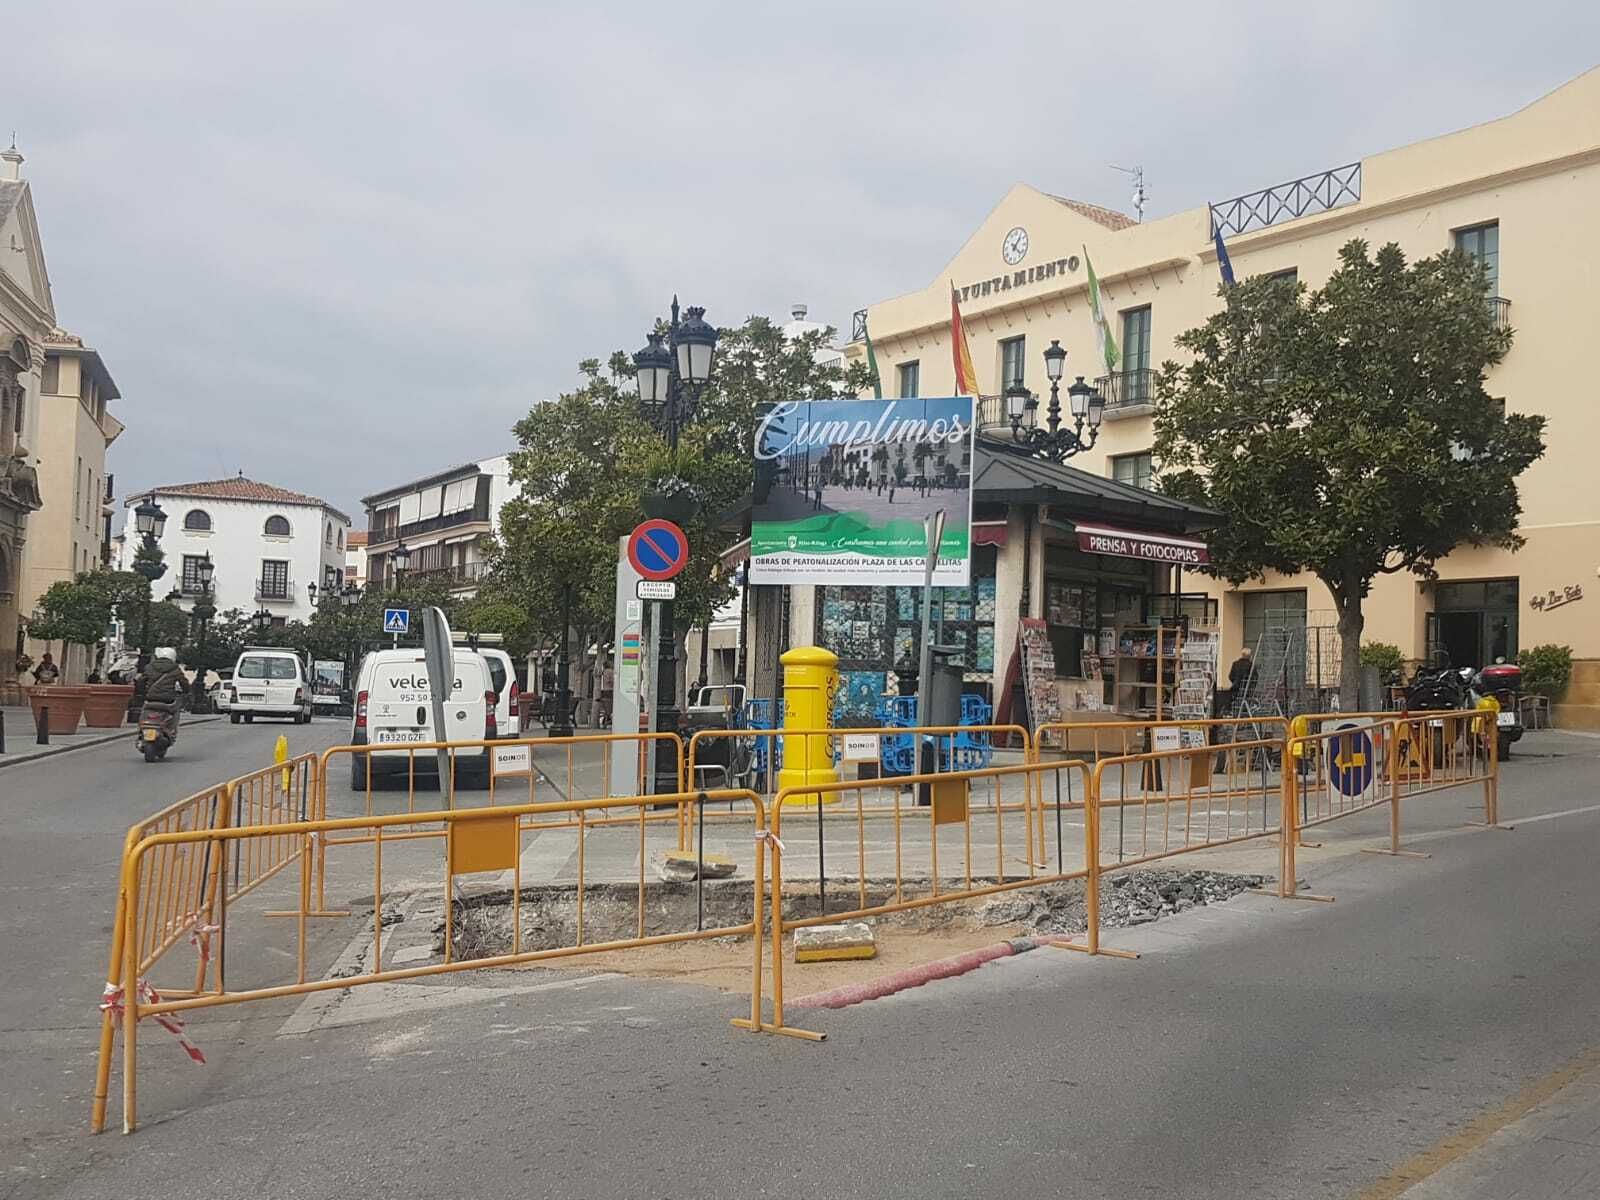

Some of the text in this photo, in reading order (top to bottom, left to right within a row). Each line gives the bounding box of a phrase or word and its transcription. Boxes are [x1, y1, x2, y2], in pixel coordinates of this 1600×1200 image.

[953, 255, 1080, 304] AYUNTAMIENTO
[754, 401, 973, 460] Cumplimos
[1090, 536, 1199, 562] PRENSA Y FOTOCOPIAS
[861, 558, 885, 566] PLAZA
[887, 558, 897, 566] DE
[899, 558, 913, 566] LAS
[389, 673, 463, 689] velea
[400, 693, 415, 703] 952
[385, 733, 407, 742] 9320
